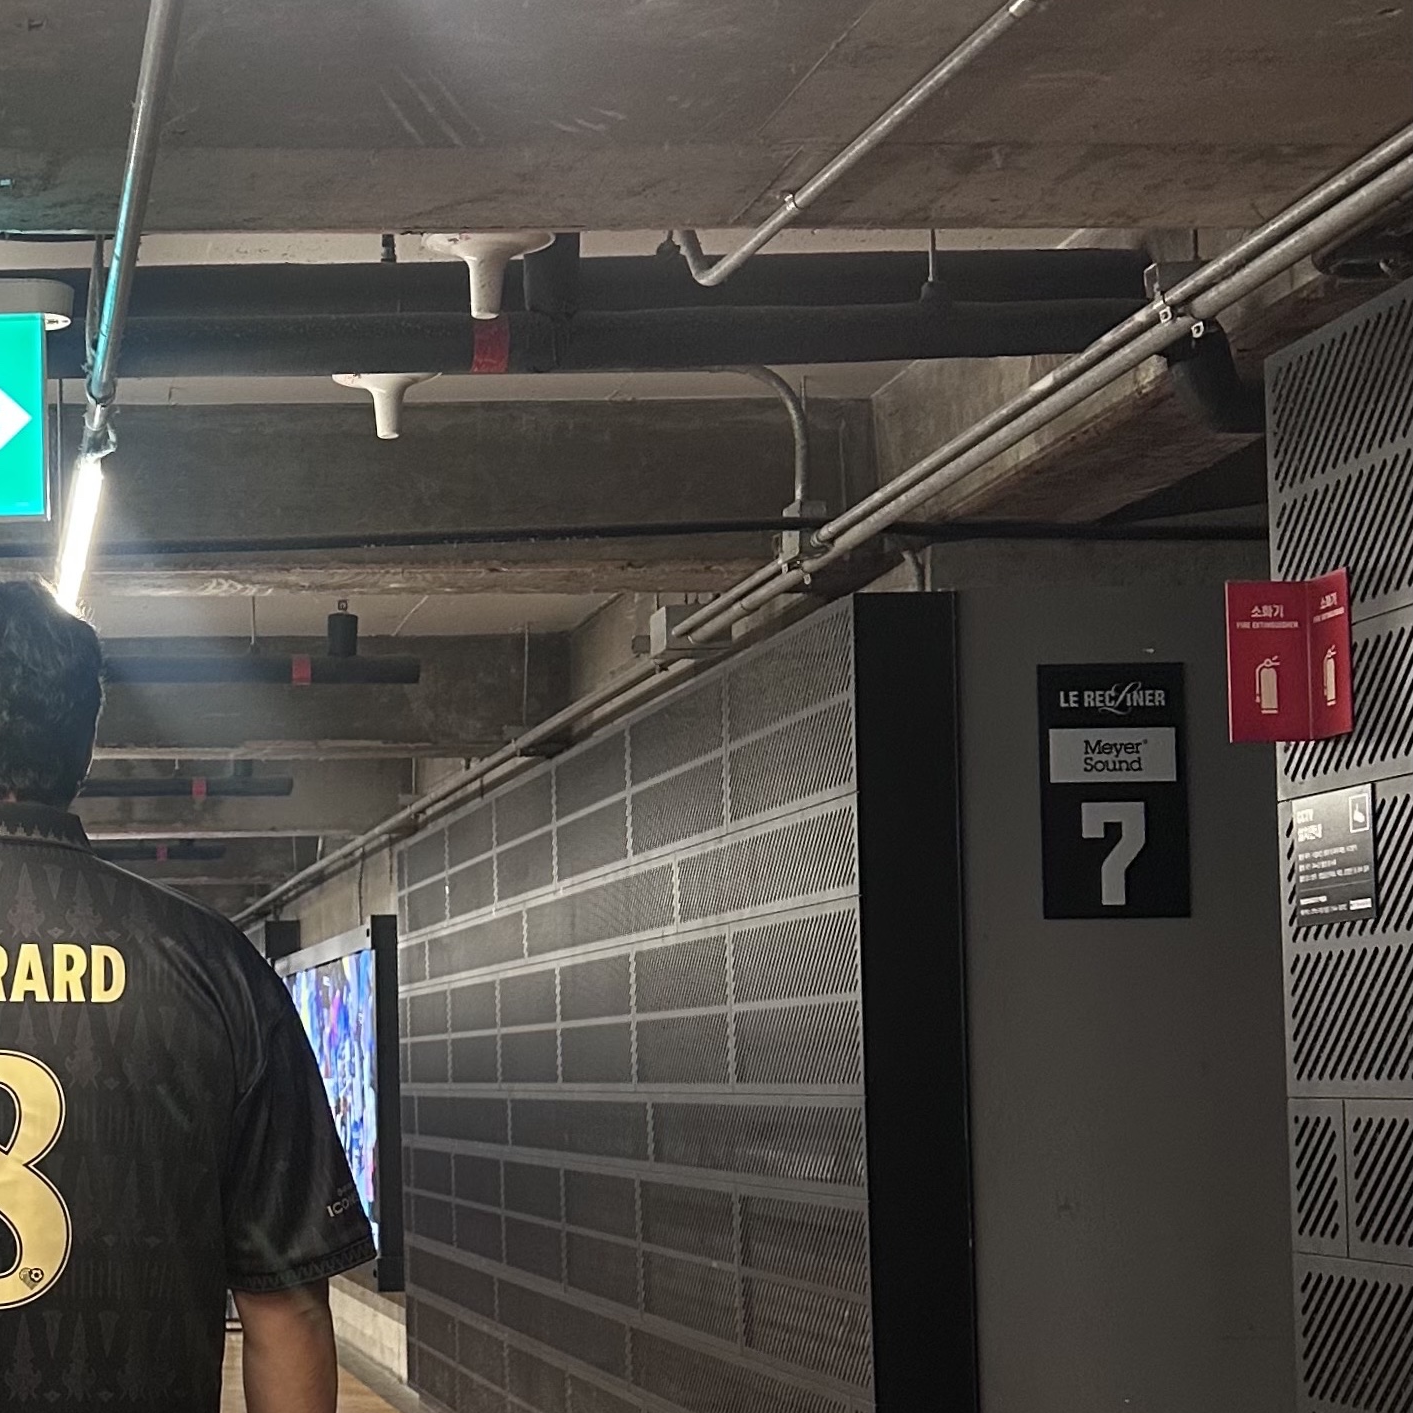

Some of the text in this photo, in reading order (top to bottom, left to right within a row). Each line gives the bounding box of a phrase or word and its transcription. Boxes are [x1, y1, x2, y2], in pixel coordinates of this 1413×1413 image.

[1250, 604, 1284, 618] 소화기
[1059, 690, 1079, 708] LE
[1083, 739, 1143, 758] Meyer
[1083, 756, 1143, 772] Sound
[1081, 801, 1146, 906] 7
